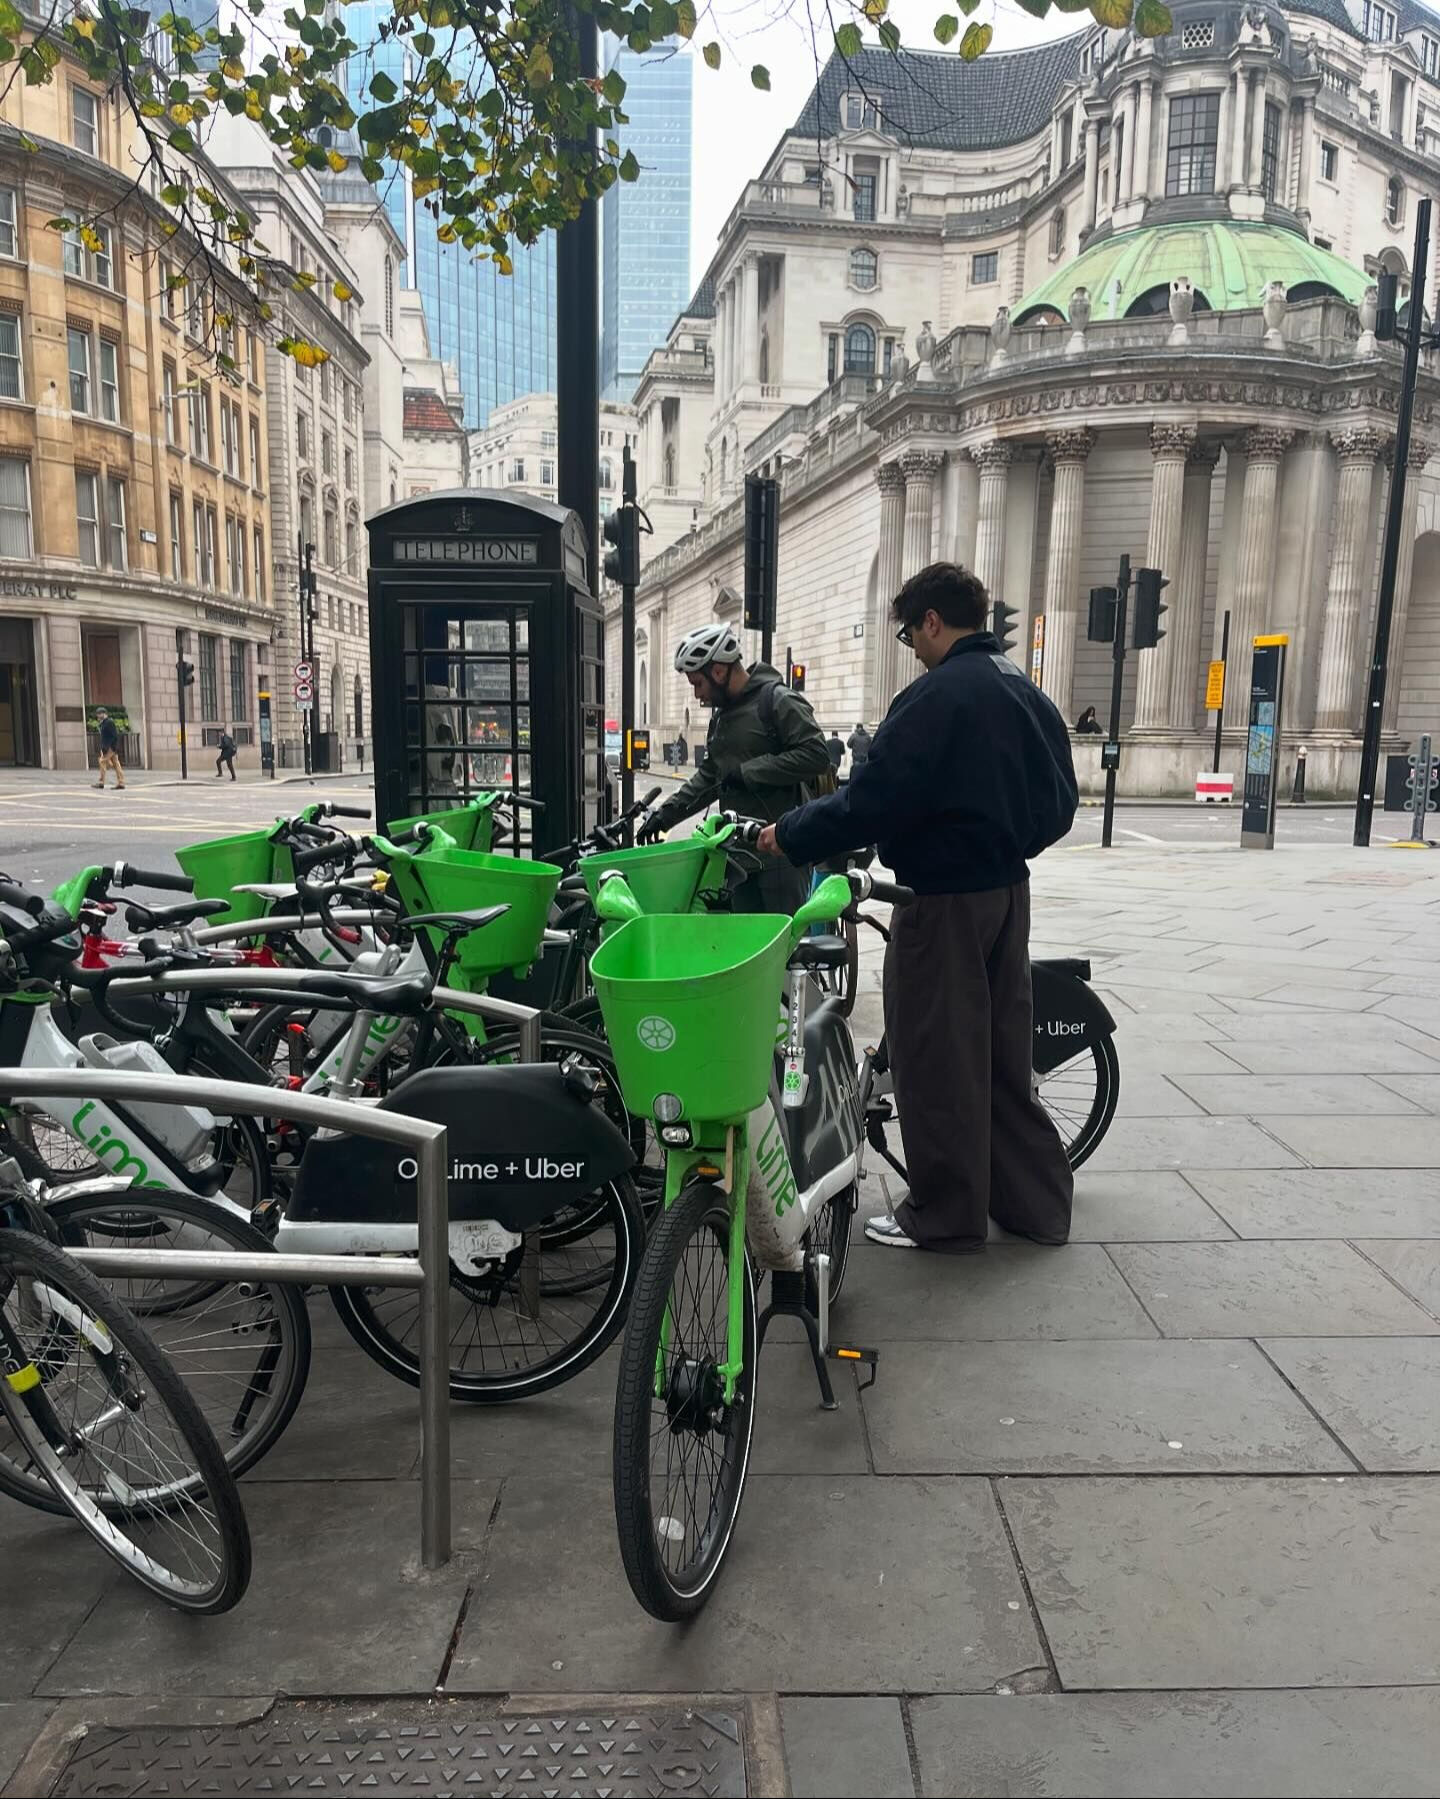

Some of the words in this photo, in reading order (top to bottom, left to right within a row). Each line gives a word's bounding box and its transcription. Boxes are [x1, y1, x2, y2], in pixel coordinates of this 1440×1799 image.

[401, 541, 533, 561] TELEPHONE
[1047, 1020, 1086, 1036] Uber
[72, 1101, 170, 1188] Lim
[398, 1158, 419, 1180] O
[447, 1158, 499, 1180] ime
[525, 1157, 585, 1180] Uber
[756, 1114, 796, 1217] Lime
